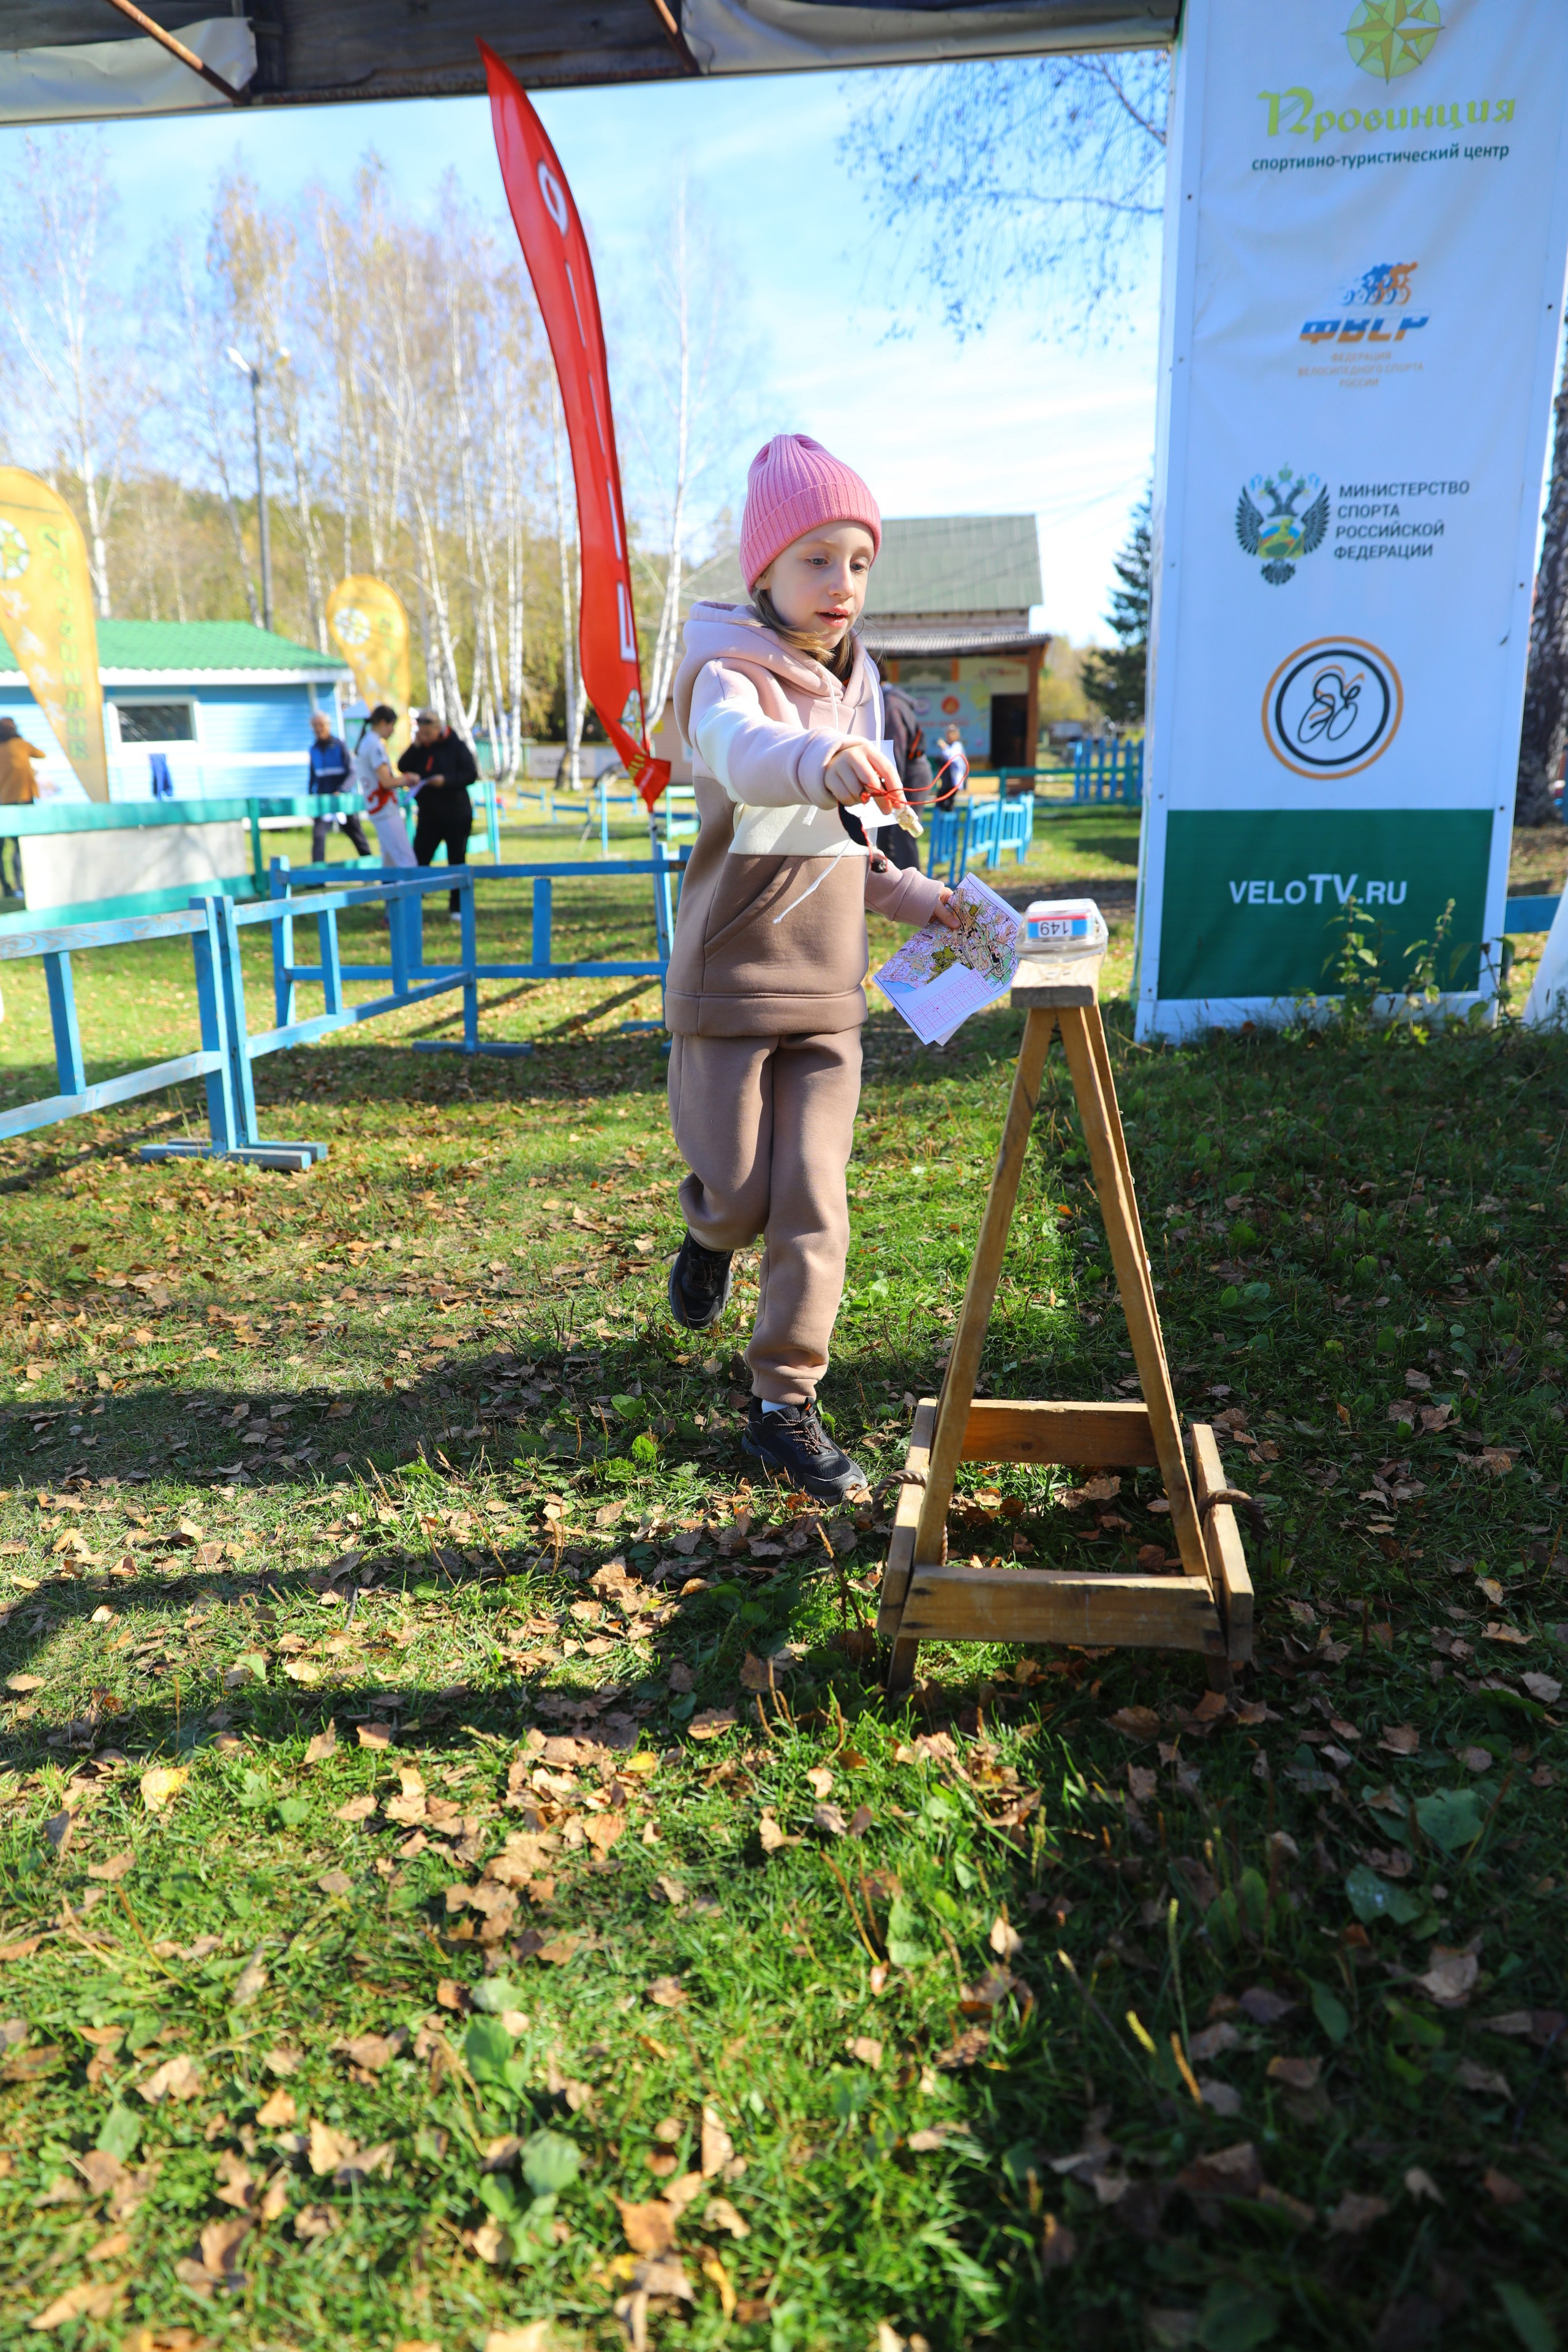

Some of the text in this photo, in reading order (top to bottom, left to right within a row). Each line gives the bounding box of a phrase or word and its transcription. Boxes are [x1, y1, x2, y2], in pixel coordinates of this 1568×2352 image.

[1257, 86, 1516, 143] Провинция
[1251, 143, 1510, 173] спортивно-туристический центр
[1339, 480, 1470, 498] МИНИСТЕРСТВО
[1337, 503, 1400, 519] СПОРТА
[1335, 519, 1445, 539] РОССИЙСКОЙ
[1334, 543, 1434, 561] ФЕДЕРАЦИИ
[1229, 873, 1408, 905] VELOTV.RU
[1040, 921, 1069, 936] 149
